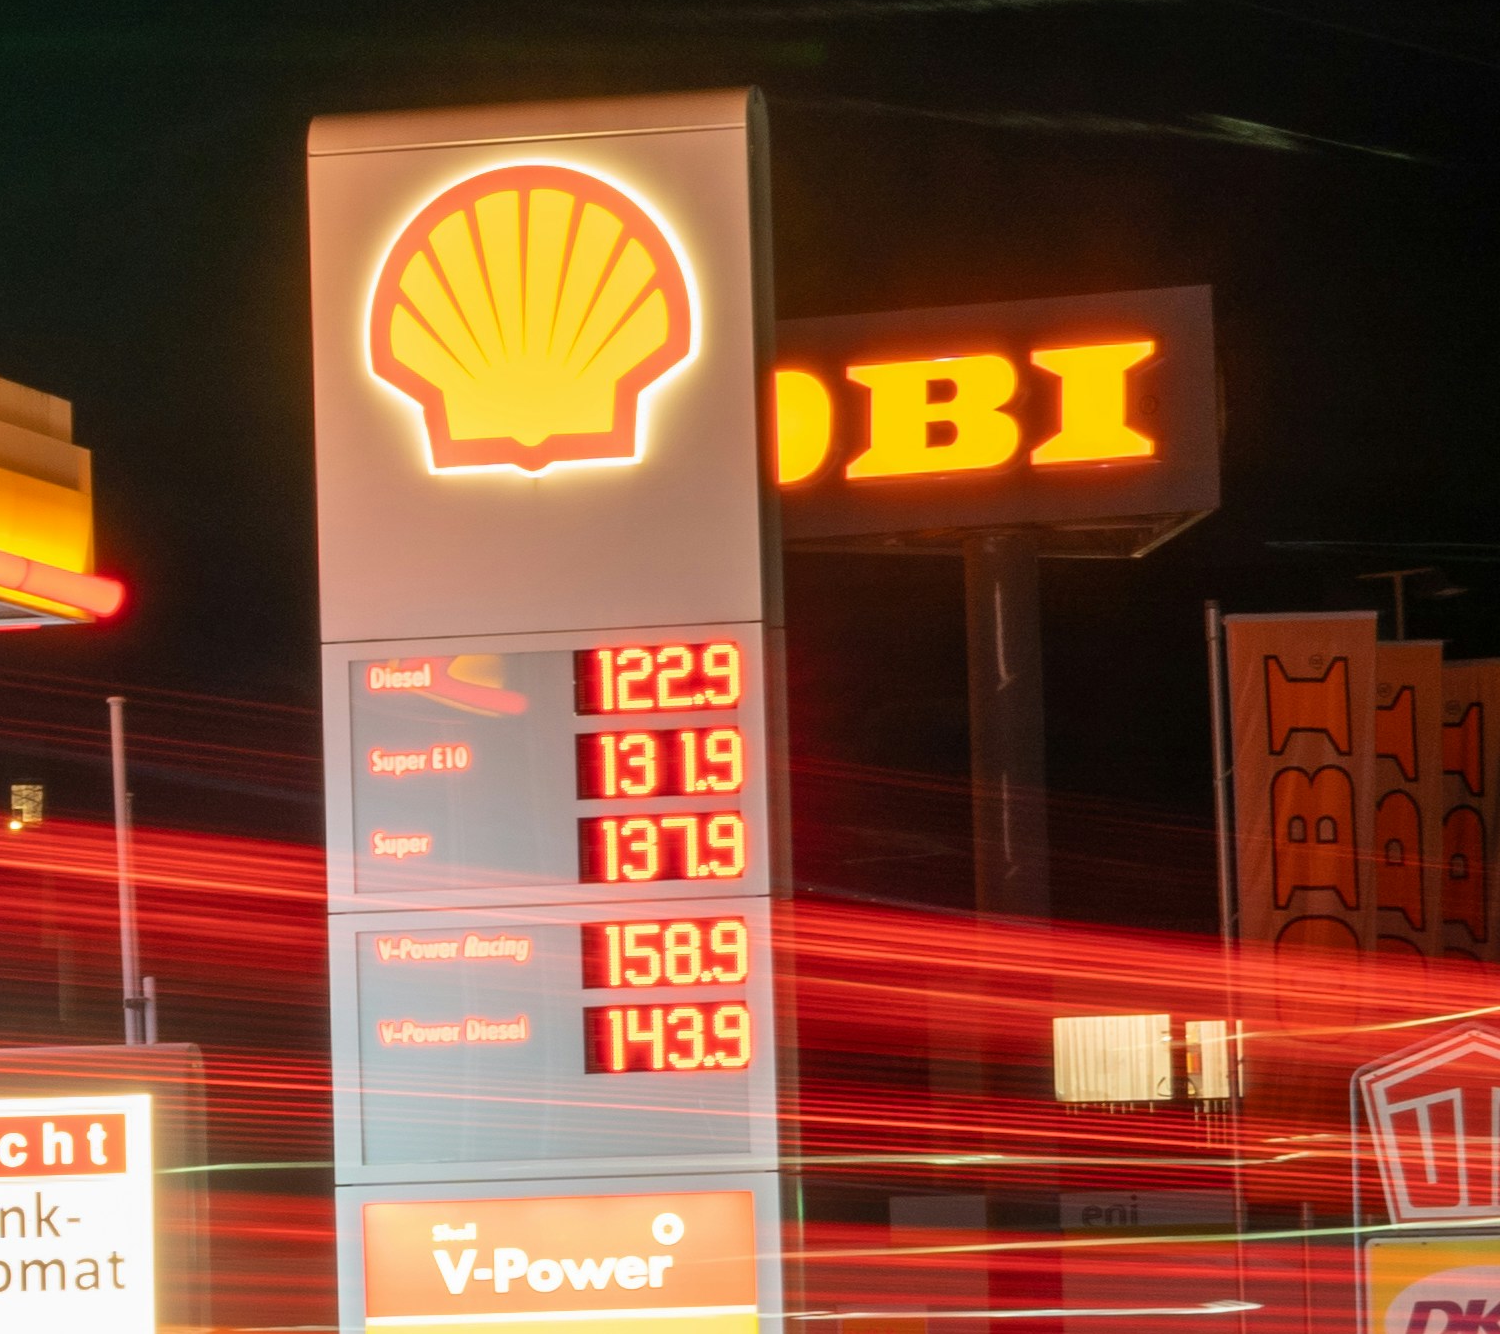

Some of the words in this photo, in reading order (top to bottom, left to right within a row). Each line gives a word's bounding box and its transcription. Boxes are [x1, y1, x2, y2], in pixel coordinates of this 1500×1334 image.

[369, 663, 431, 689] Diesel
[598, 643, 741, 710] 122.9
[371, 750, 427, 776] Super
[432, 746, 469, 769] E10
[601, 730, 744, 796] 131.9
[373, 832, 429, 859] Super
[603, 815, 746, 881] 137.9
[378, 938, 459, 961] V-Power
[464, 934, 530, 962] Racing
[605, 921, 748, 986] 158.9
[380, 1021, 461, 1044] V-Power
[465, 1017, 527, 1042] Diesel
[609, 1005, 751, 1071] 143.9
[432, 1222, 477, 1242] Shell
[1081, 1194, 1138, 1227] eni
[432, 1247, 674, 1295] V-Power
